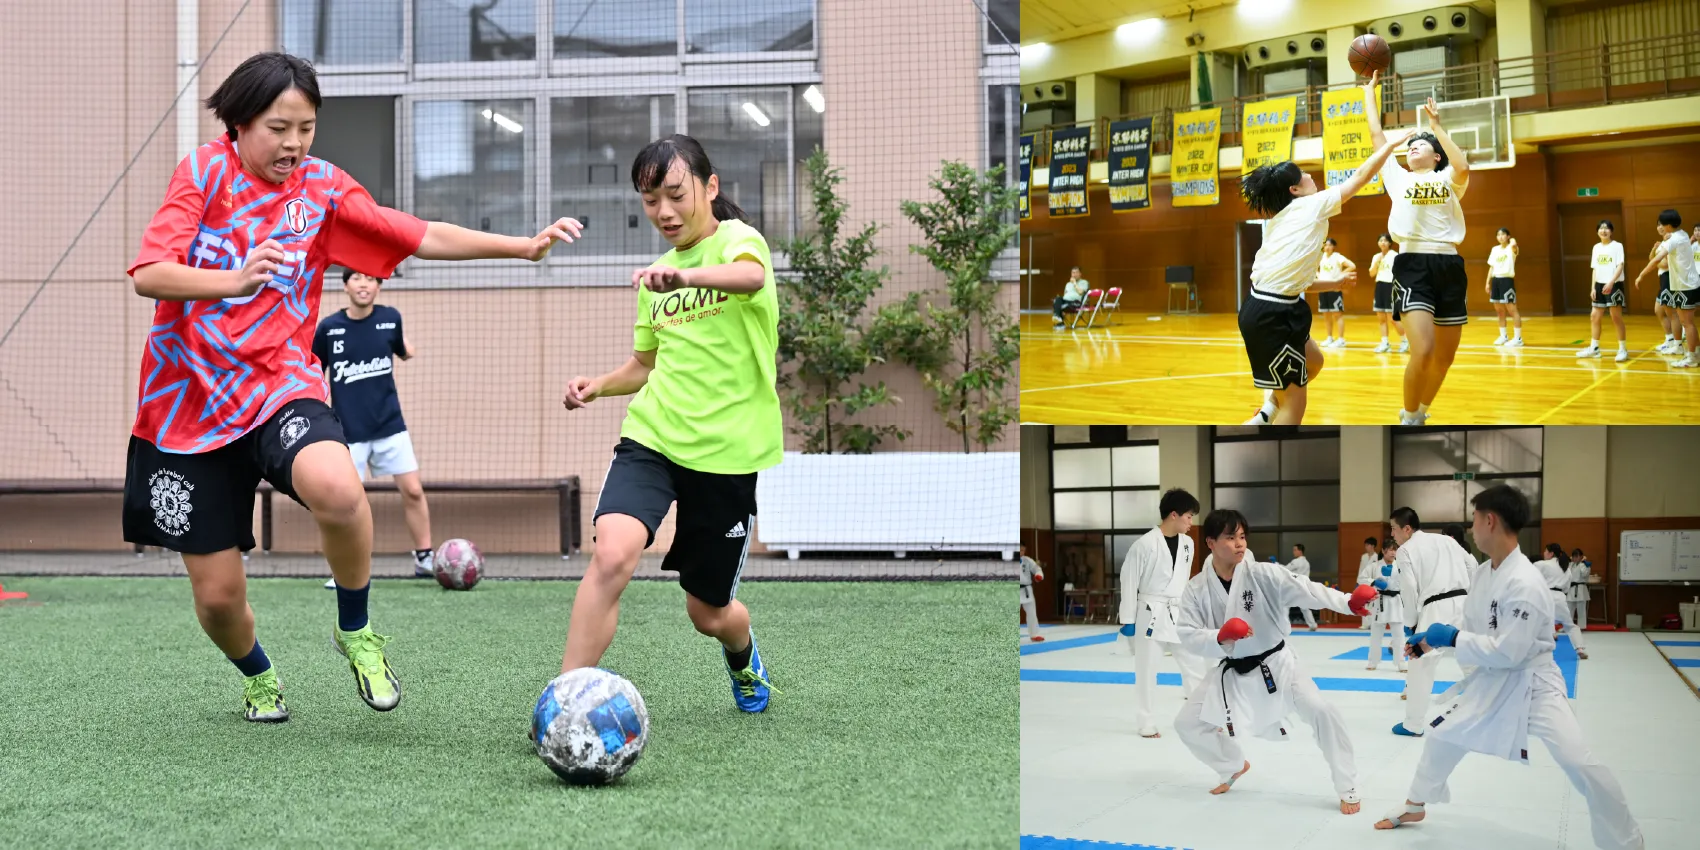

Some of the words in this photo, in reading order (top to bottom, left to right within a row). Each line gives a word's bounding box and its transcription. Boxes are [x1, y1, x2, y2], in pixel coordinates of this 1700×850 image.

[1341, 132, 1362, 145] 2024
[1329, 147, 1358, 161] WINTER
[1404, 187, 1450, 199] SEIKA
[685, 312, 695, 323] de
